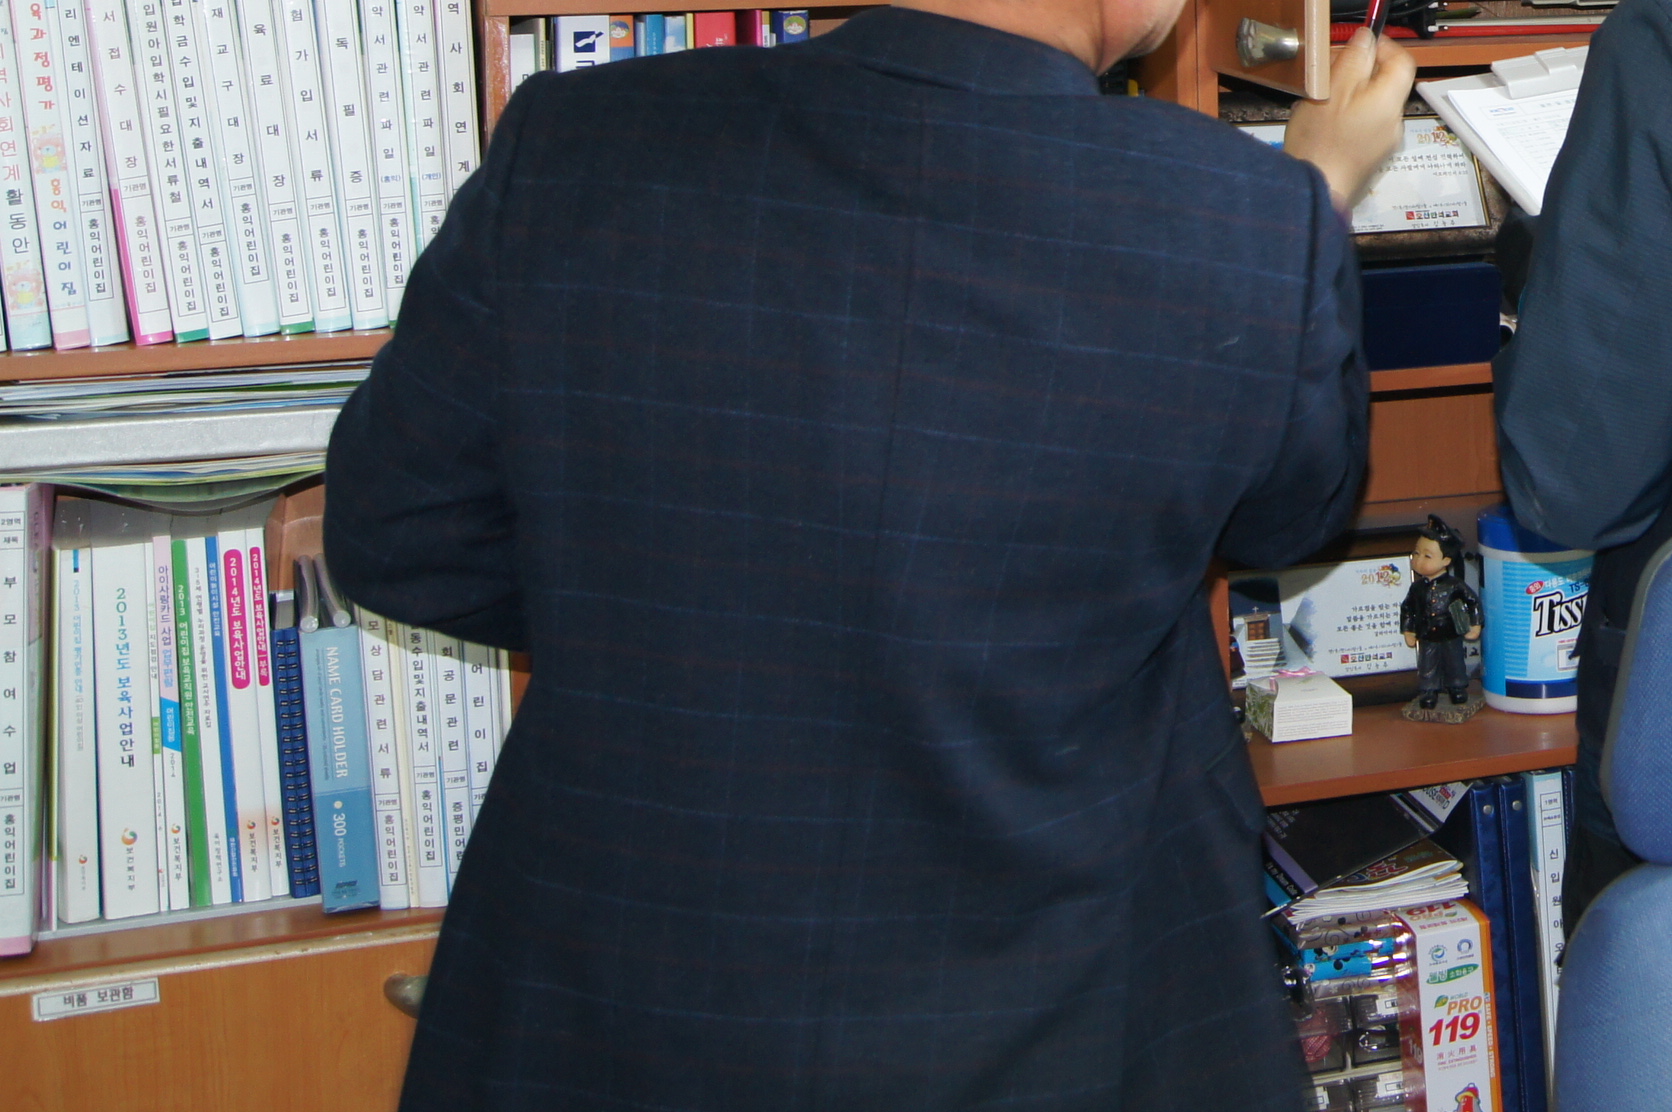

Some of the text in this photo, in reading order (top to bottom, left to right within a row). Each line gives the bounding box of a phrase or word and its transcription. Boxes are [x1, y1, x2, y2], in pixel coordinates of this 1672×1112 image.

[158, 565, 172, 647] 아이사랑카드 사업
[229, 557, 247, 681] 2014년도 보육사업안내
[179, 622, 189, 656] 어린이집
[116, 588, 136, 769] 2013년도 보육사업안내
[326, 646, 348, 778] NAME CARD HOLDER
[333, 813, 347, 837] 300
[63, 986, 135, 1008] 비품 보관함
[1447, 996, 1483, 1016] PRO
[1428, 1012, 1481, 1046] 119
